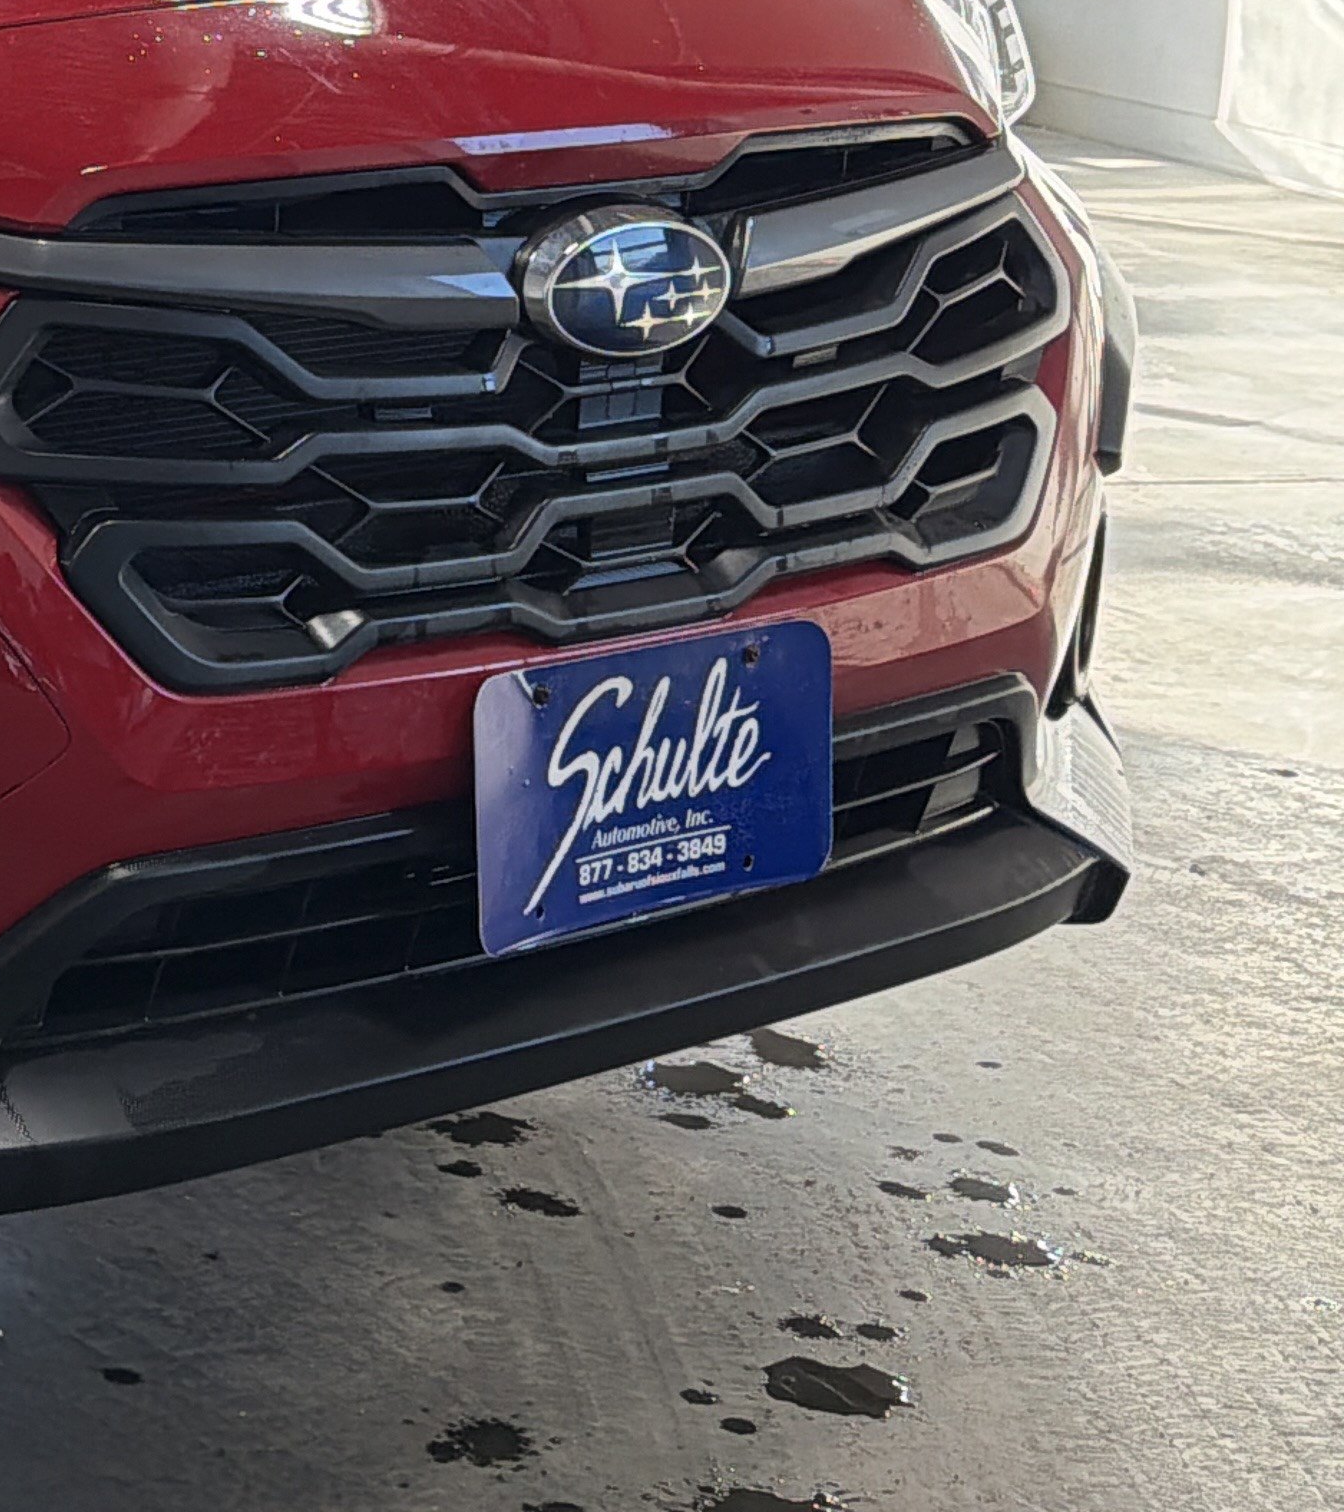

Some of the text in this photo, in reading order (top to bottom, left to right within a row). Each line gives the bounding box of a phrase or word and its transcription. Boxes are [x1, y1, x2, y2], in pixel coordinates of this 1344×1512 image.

[524, 657, 771, 916] Schulte
[591, 808, 713, 849] Automotive, Inc.
